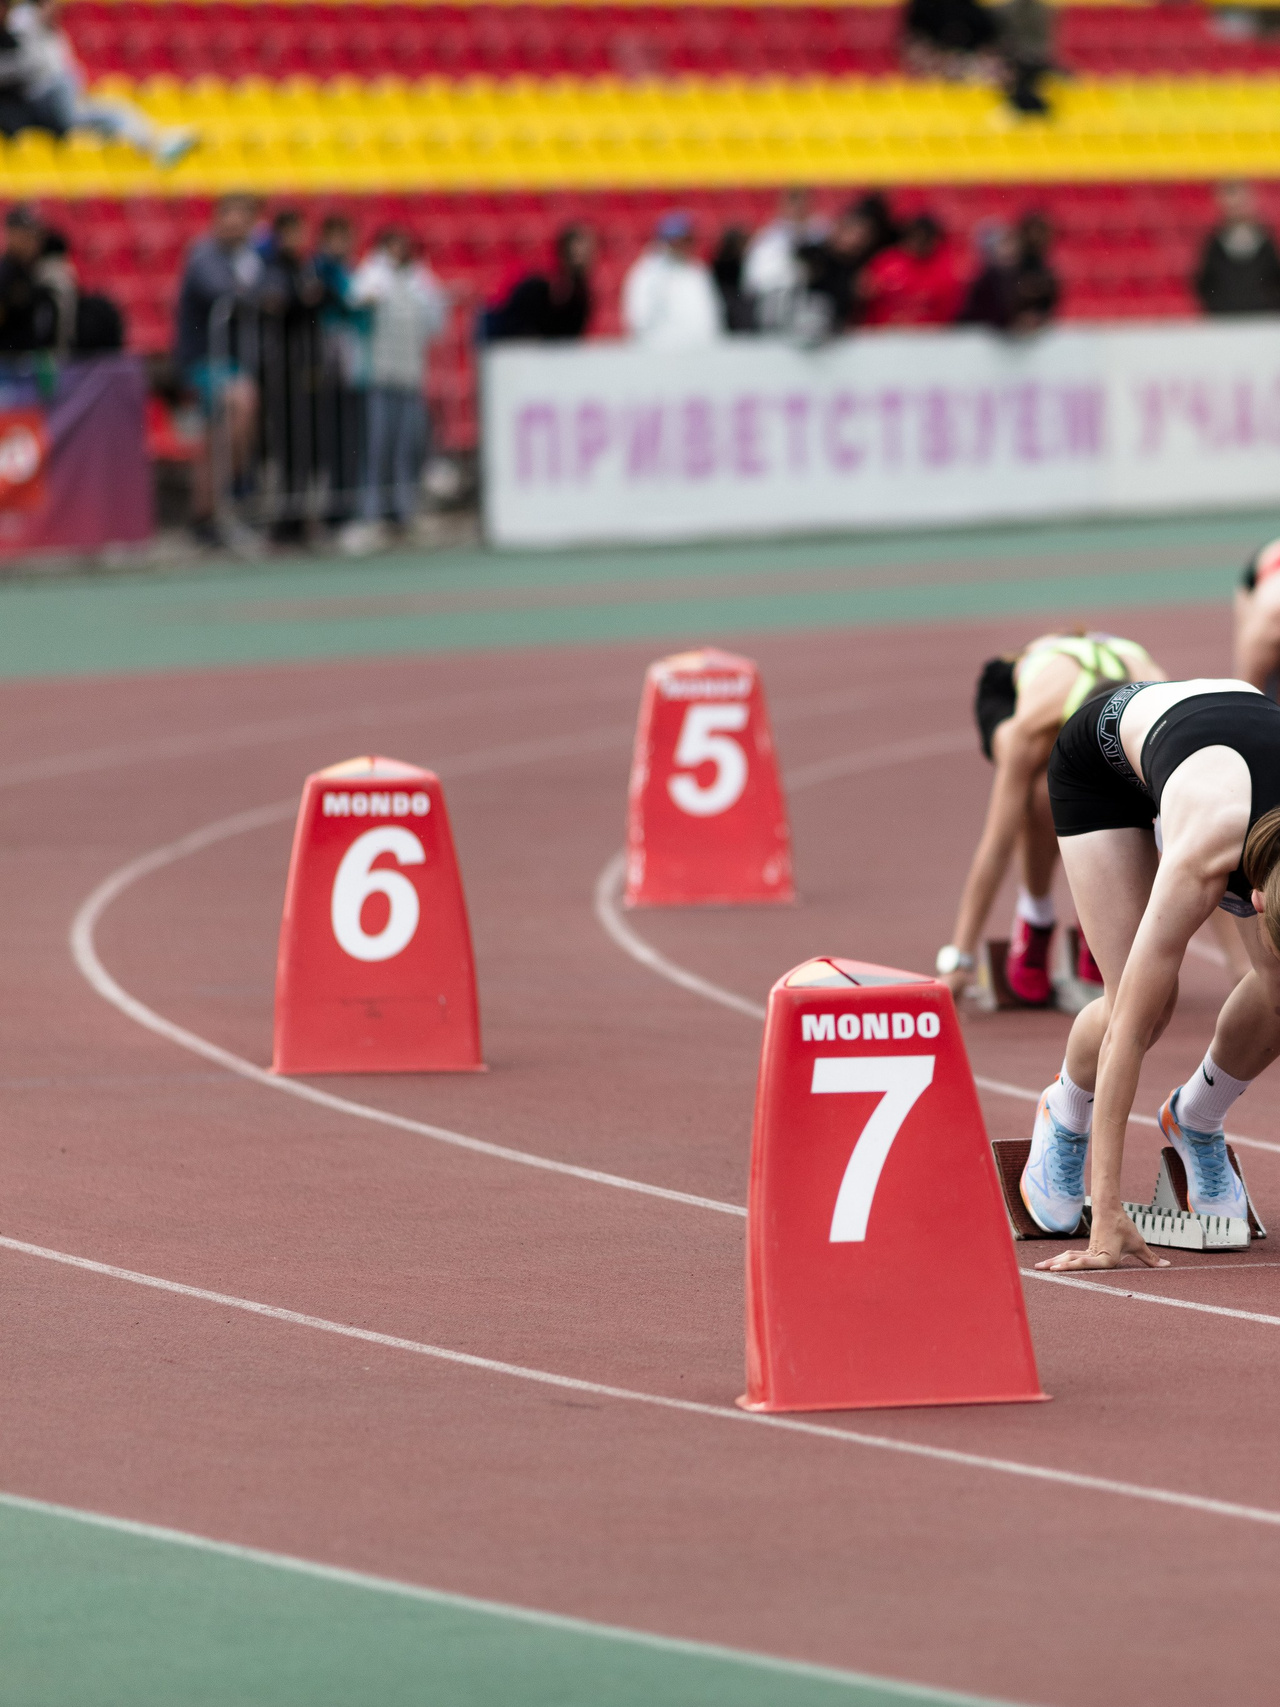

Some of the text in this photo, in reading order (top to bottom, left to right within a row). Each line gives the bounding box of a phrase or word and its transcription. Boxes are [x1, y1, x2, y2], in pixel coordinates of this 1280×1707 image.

[514, 378, 1107, 486] ПРИВЕТСТВУЕМ
[323, 792, 431, 816] MONDO
[666, 702, 750, 818] 5
[331, 825, 426, 962] 6
[801, 1011, 941, 1042] MONDO
[811, 1054, 936, 1243] 7
